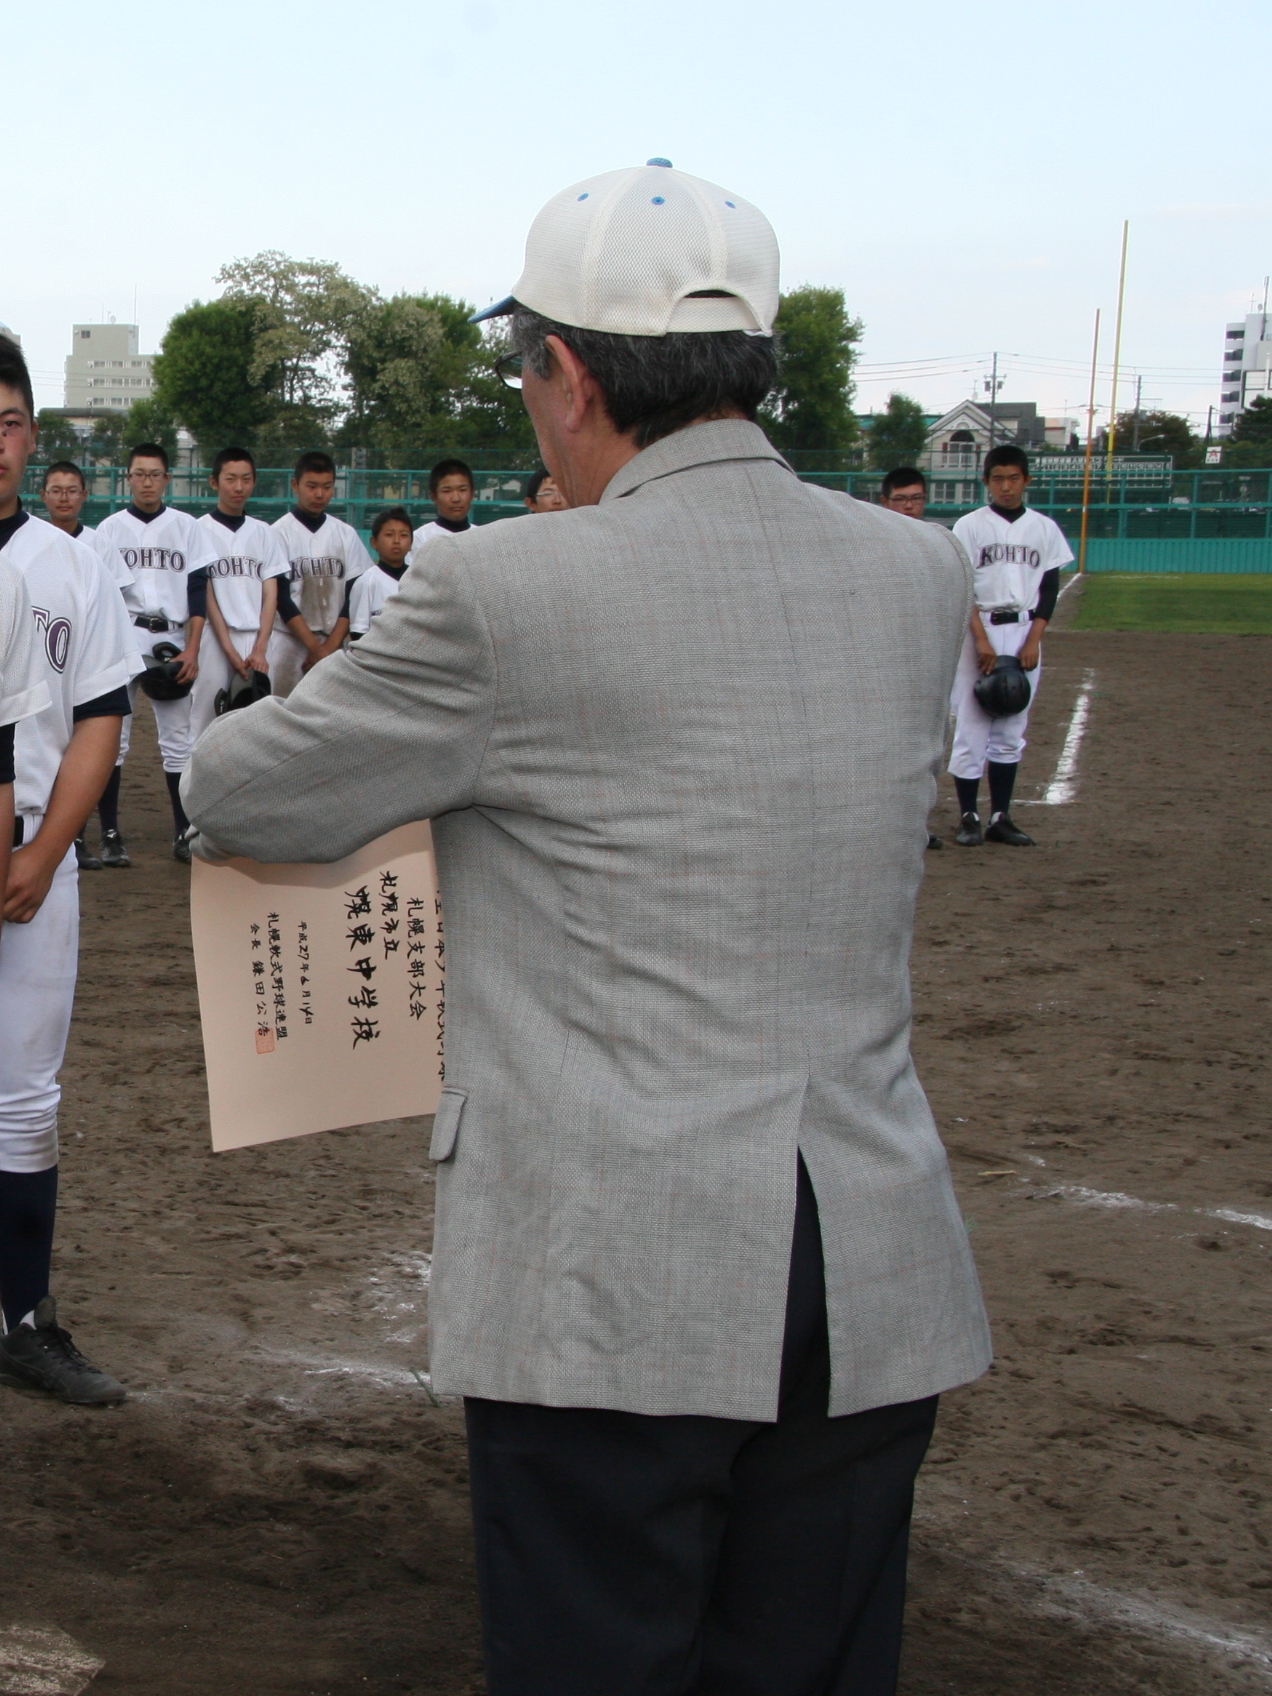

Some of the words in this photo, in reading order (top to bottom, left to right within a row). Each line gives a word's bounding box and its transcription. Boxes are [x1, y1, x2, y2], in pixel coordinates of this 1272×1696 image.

[119, 547, 186, 573] OHTO
[976, 543, 1040, 570] KOHTO
[379, 871, 400, 960] 札幌市立
[406, 897, 427, 1021] 札幌支部大会
[344, 885, 381, 1050] 幌東中学校
